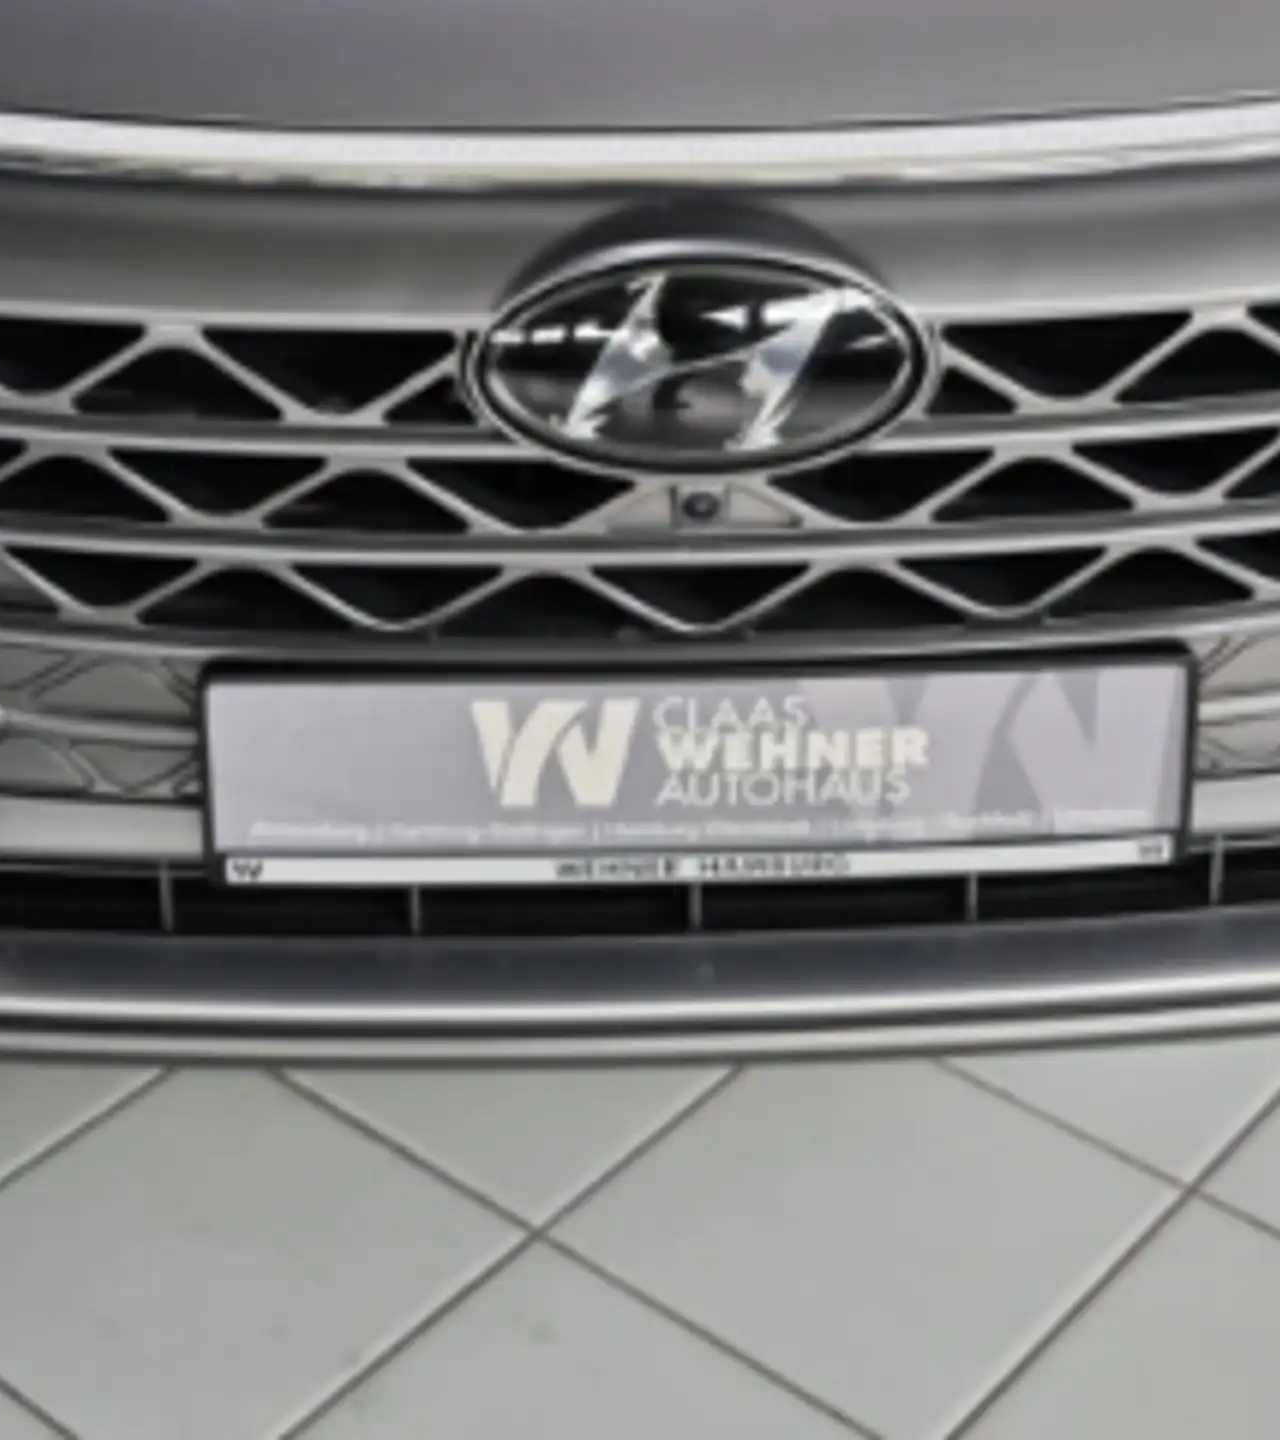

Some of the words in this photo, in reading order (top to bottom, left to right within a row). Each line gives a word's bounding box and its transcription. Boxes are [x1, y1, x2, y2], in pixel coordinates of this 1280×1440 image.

[651, 694, 809, 734] CLAAS
[656, 726, 931, 772] WEHNER
[653, 766, 912, 808] AUTOHAUS
